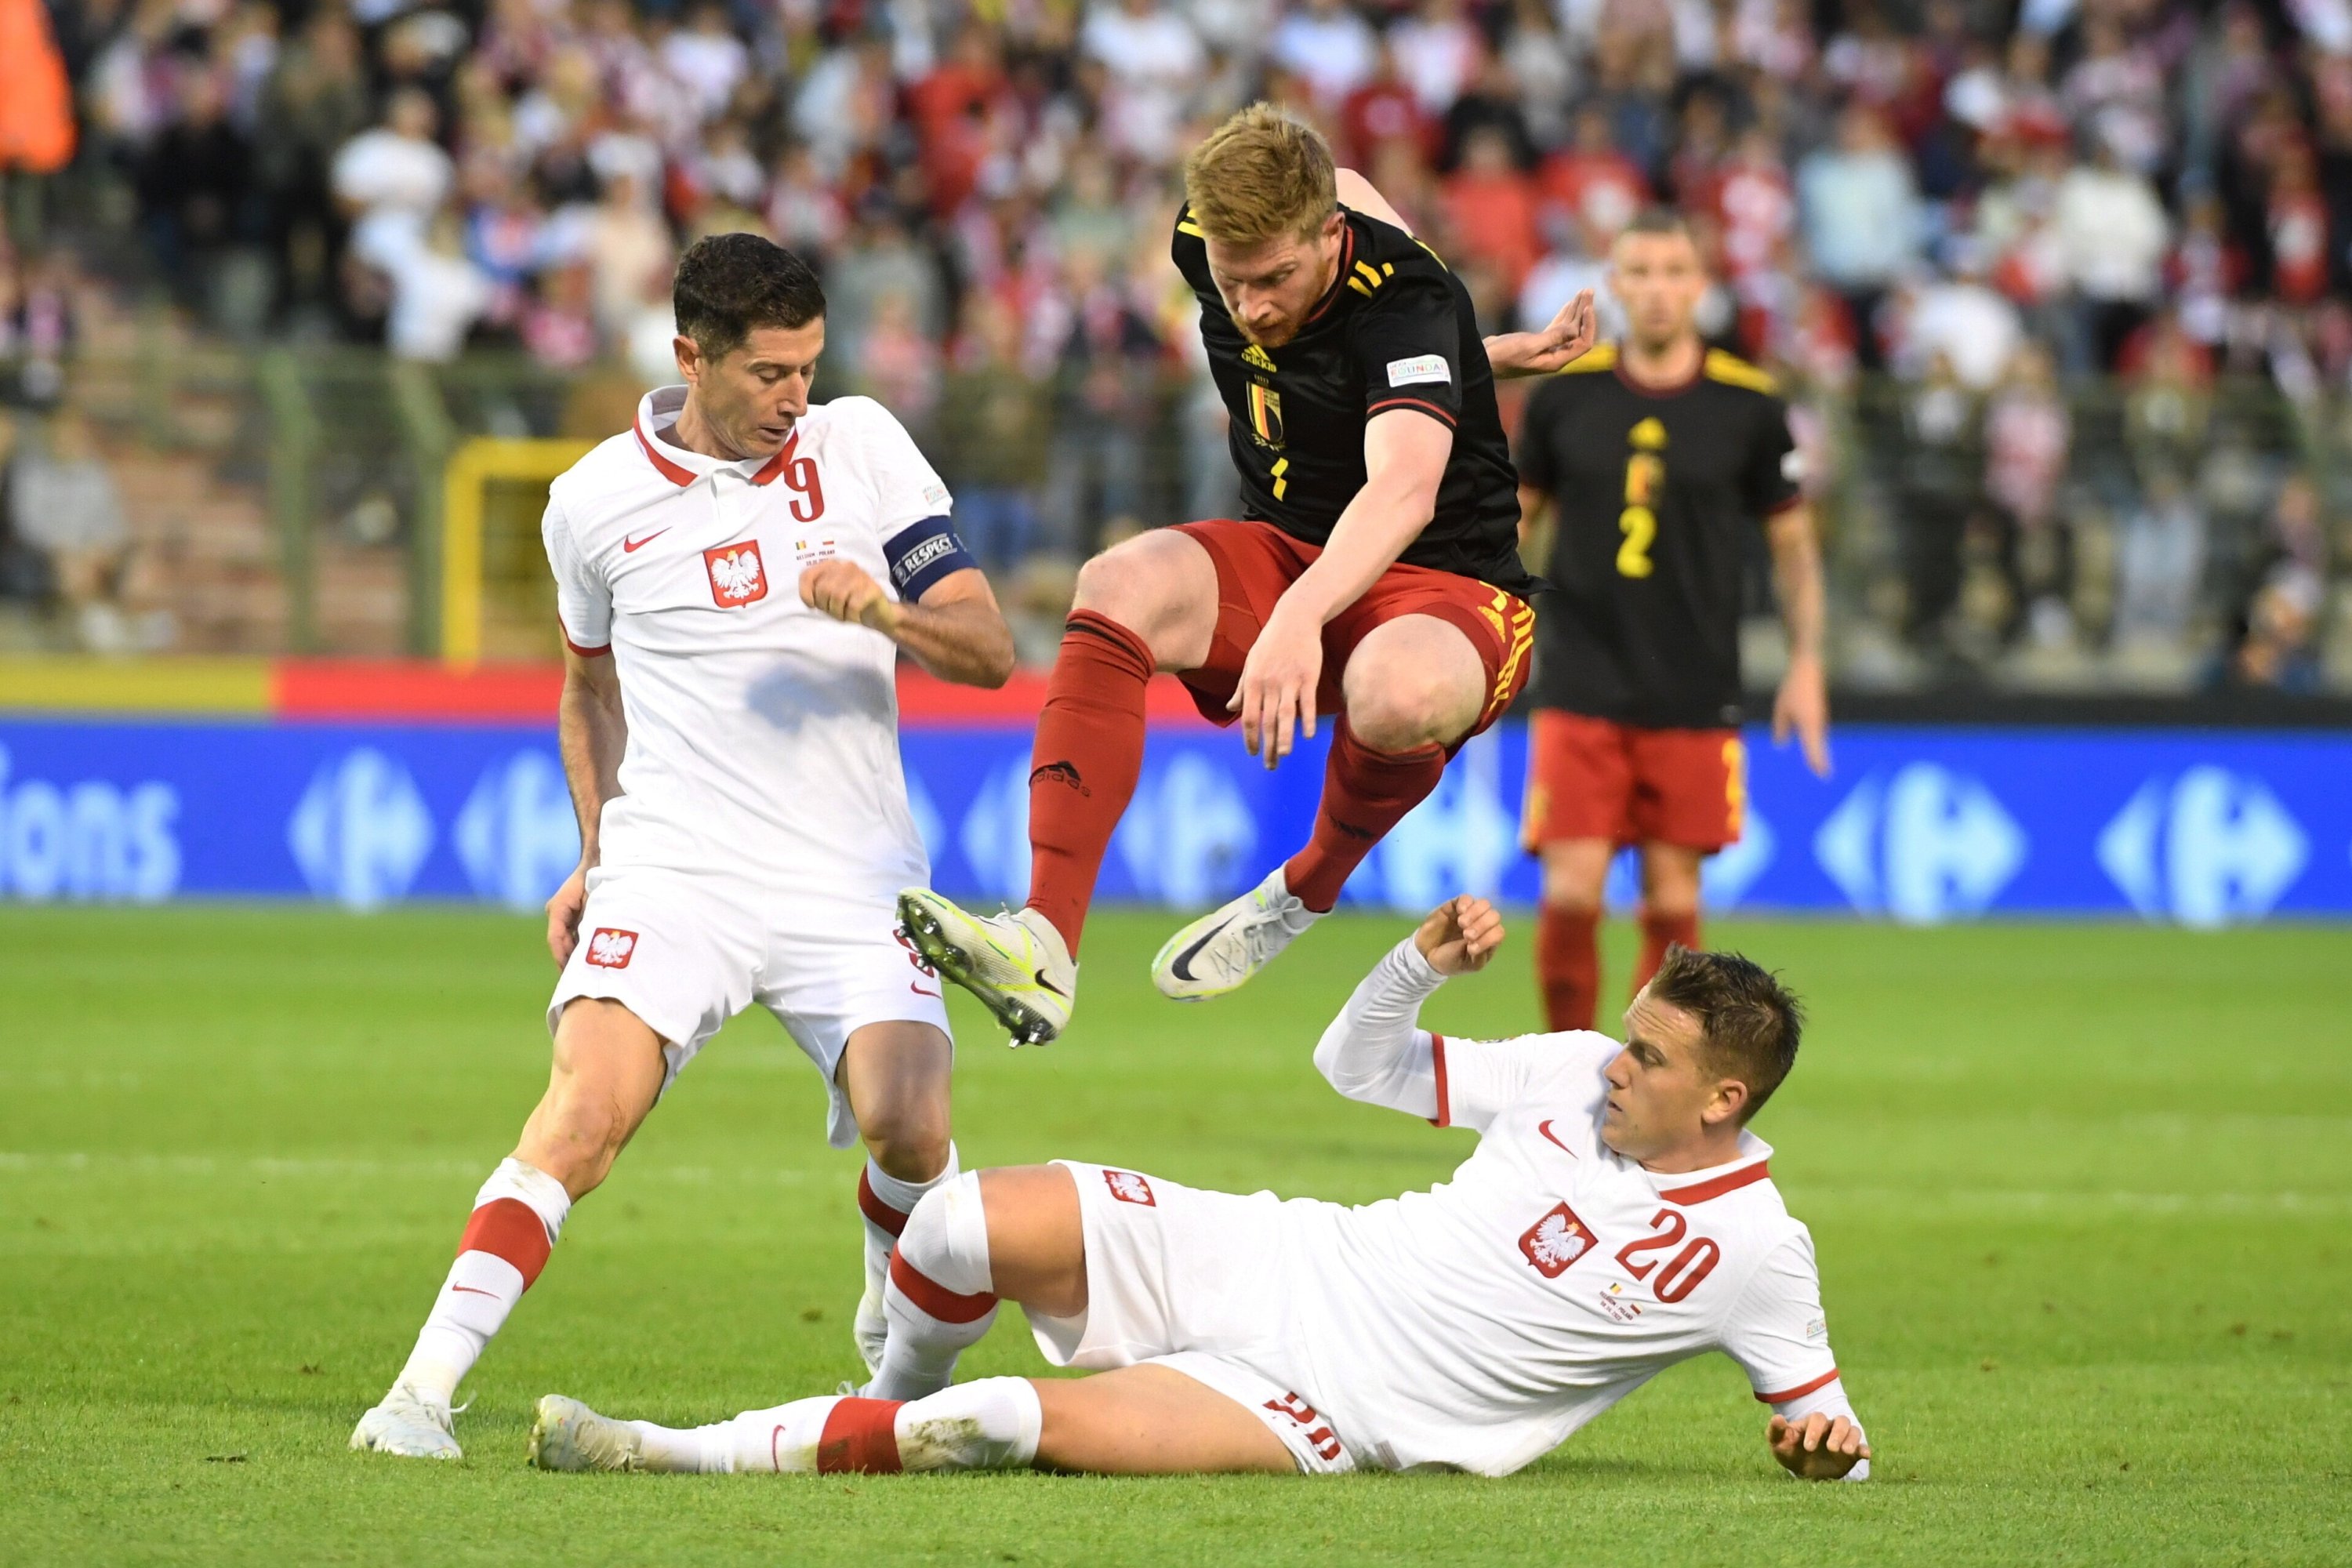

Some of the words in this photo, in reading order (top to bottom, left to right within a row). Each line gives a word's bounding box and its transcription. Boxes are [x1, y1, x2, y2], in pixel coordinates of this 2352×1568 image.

[1241, 352, 1277, 372] adidas
[784, 457, 825, 523] 9
[904, 537, 953, 572] RESPECT
[1616, 505, 1657, 579] 2
[1615, 1208, 1720, 1304] 20
